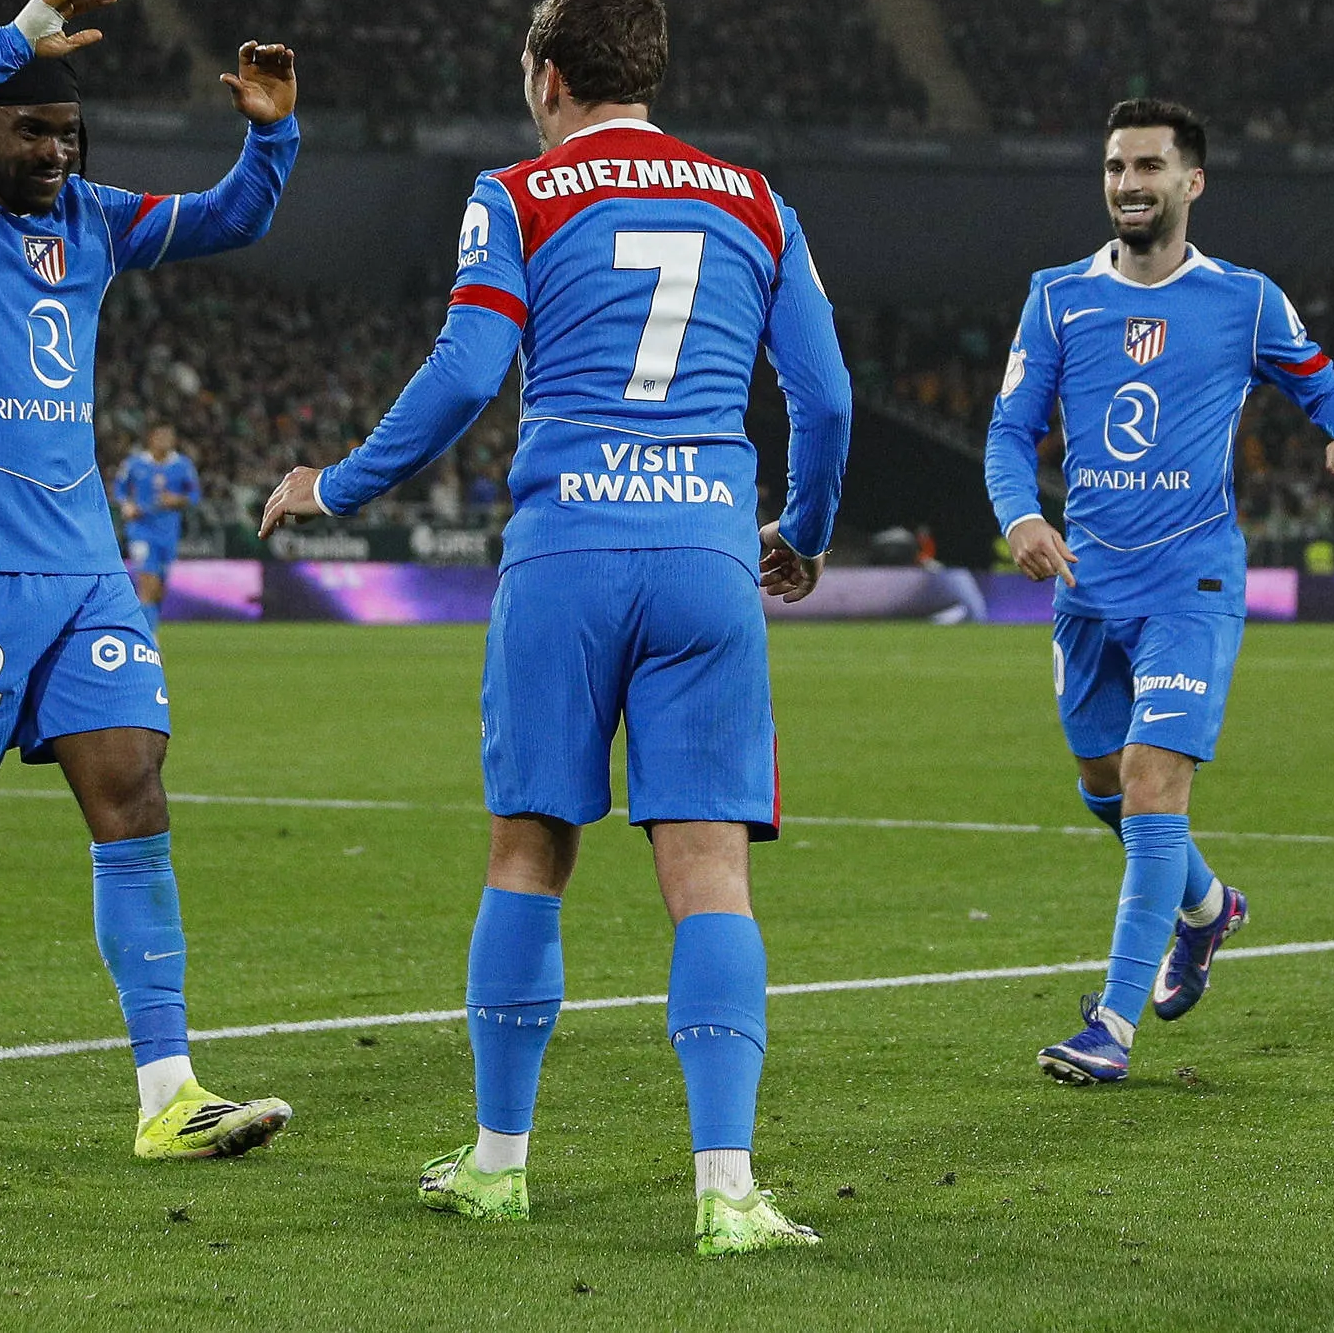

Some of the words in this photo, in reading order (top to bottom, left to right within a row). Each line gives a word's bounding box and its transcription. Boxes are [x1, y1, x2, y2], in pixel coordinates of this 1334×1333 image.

[527, 159, 755, 200] GRIEZMANN
[613, 230, 706, 402] 7
[601, 443, 698, 472] VISIT
[560, 472, 734, 507] RWANDA
[1079, 468, 1146, 490] RIYADH
[1152, 471, 1191, 490] AIR
